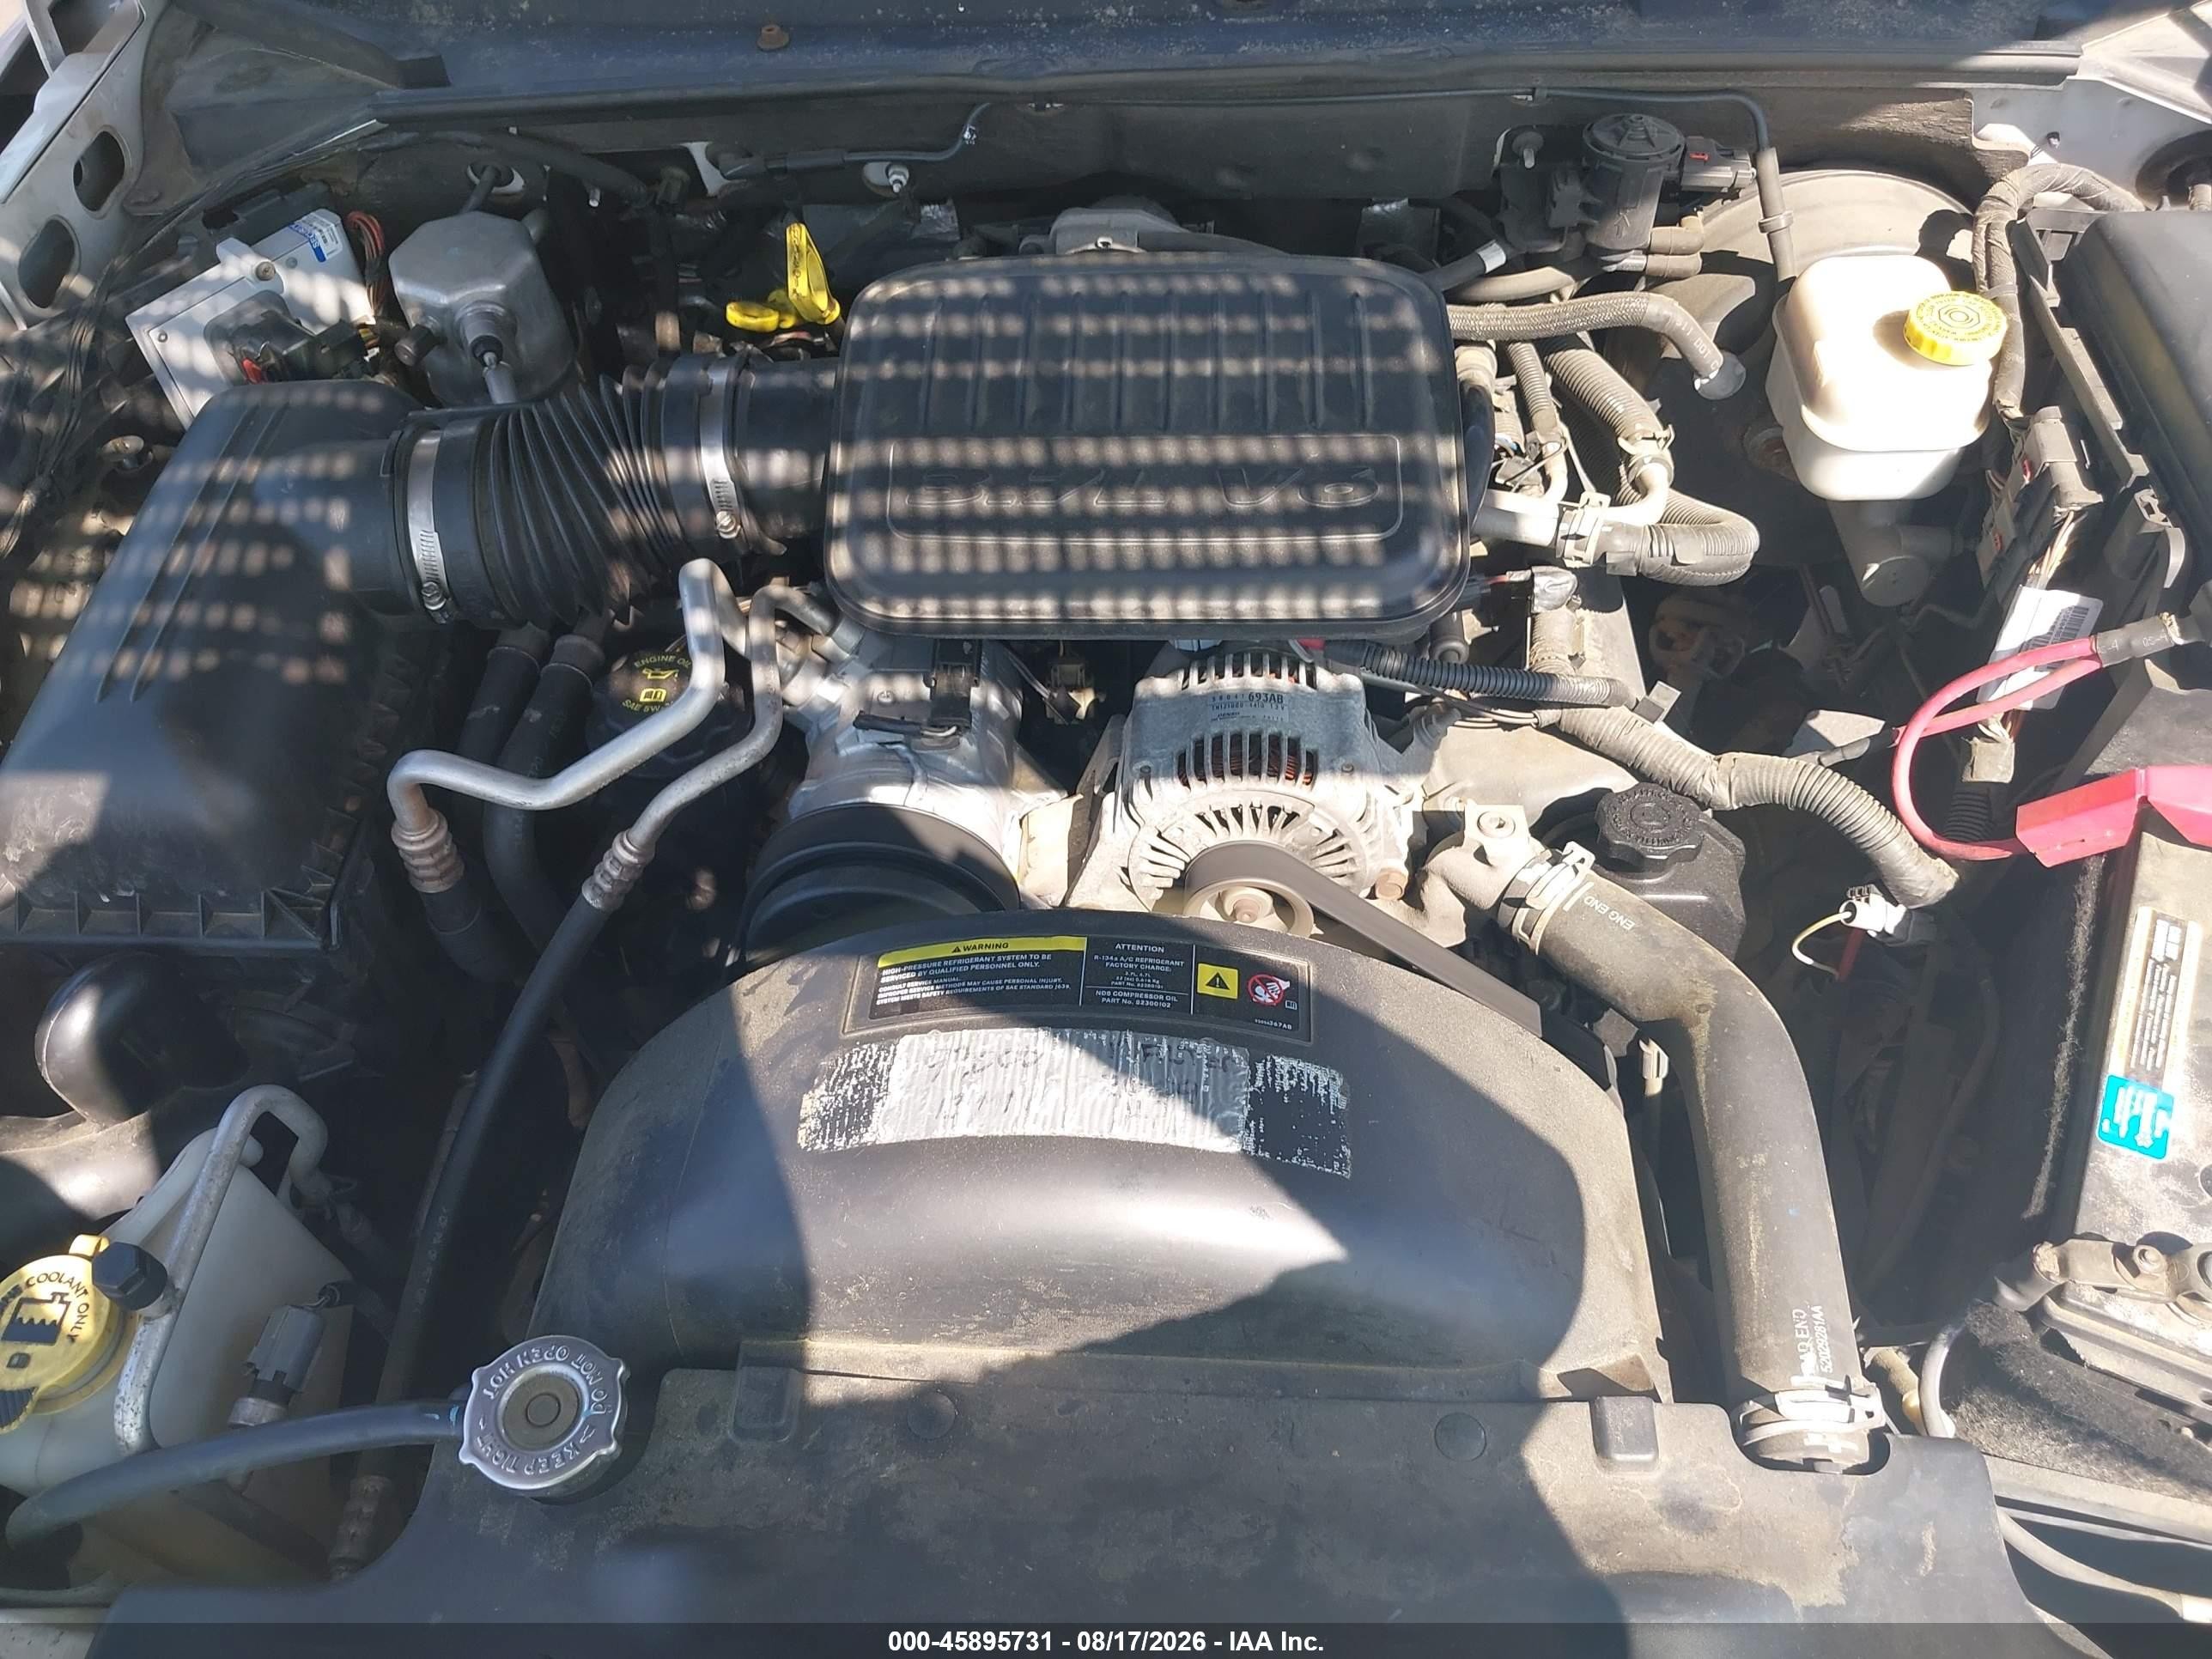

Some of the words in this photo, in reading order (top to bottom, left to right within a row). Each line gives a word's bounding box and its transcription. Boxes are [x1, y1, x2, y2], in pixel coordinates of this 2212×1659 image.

[1693, 337, 1711, 359] DOT
[1216, 466, 1380, 507] V6
[634, 655, 677, 668] ENGINE
[677, 658, 692, 669] OIL
[622, 699, 641, 712] SAE
[1248, 691, 1284, 704] 693AB
[1583, 896, 1610, 915] END
[1607, 910, 1636, 931] ENG
[963, 942, 1009, 951] WARNING
[1115, 943, 1164, 953] ATTENTION
[880, 971, 916, 983] SERVICED
[928, 965, 969, 975] QUALIFIED
[969, 962, 1017, 970] PERSONNEL
[882, 960, 943, 976] HIGH-PRESSURE
[943, 956, 996, 966] REFRIGERANT
[1134, 957, 1184, 967] REFRIGERANT
[1112, 990, 1164, 1001] COMPRESSOR
[26, 1271, 88, 1298] COOLANT
[67, 1304, 90, 1343] ONLY
[1792, 1309, 1810, 1338] END
[516, 1346, 569, 1368] OPEN
[570, 1353, 604, 1386] NOT
[483, 1362, 516, 1400] HOT
[590, 1388, 608, 1415] DO
[477, 1433, 517, 1474] TIGHT
[524, 1442, 581, 1476] KEEP
